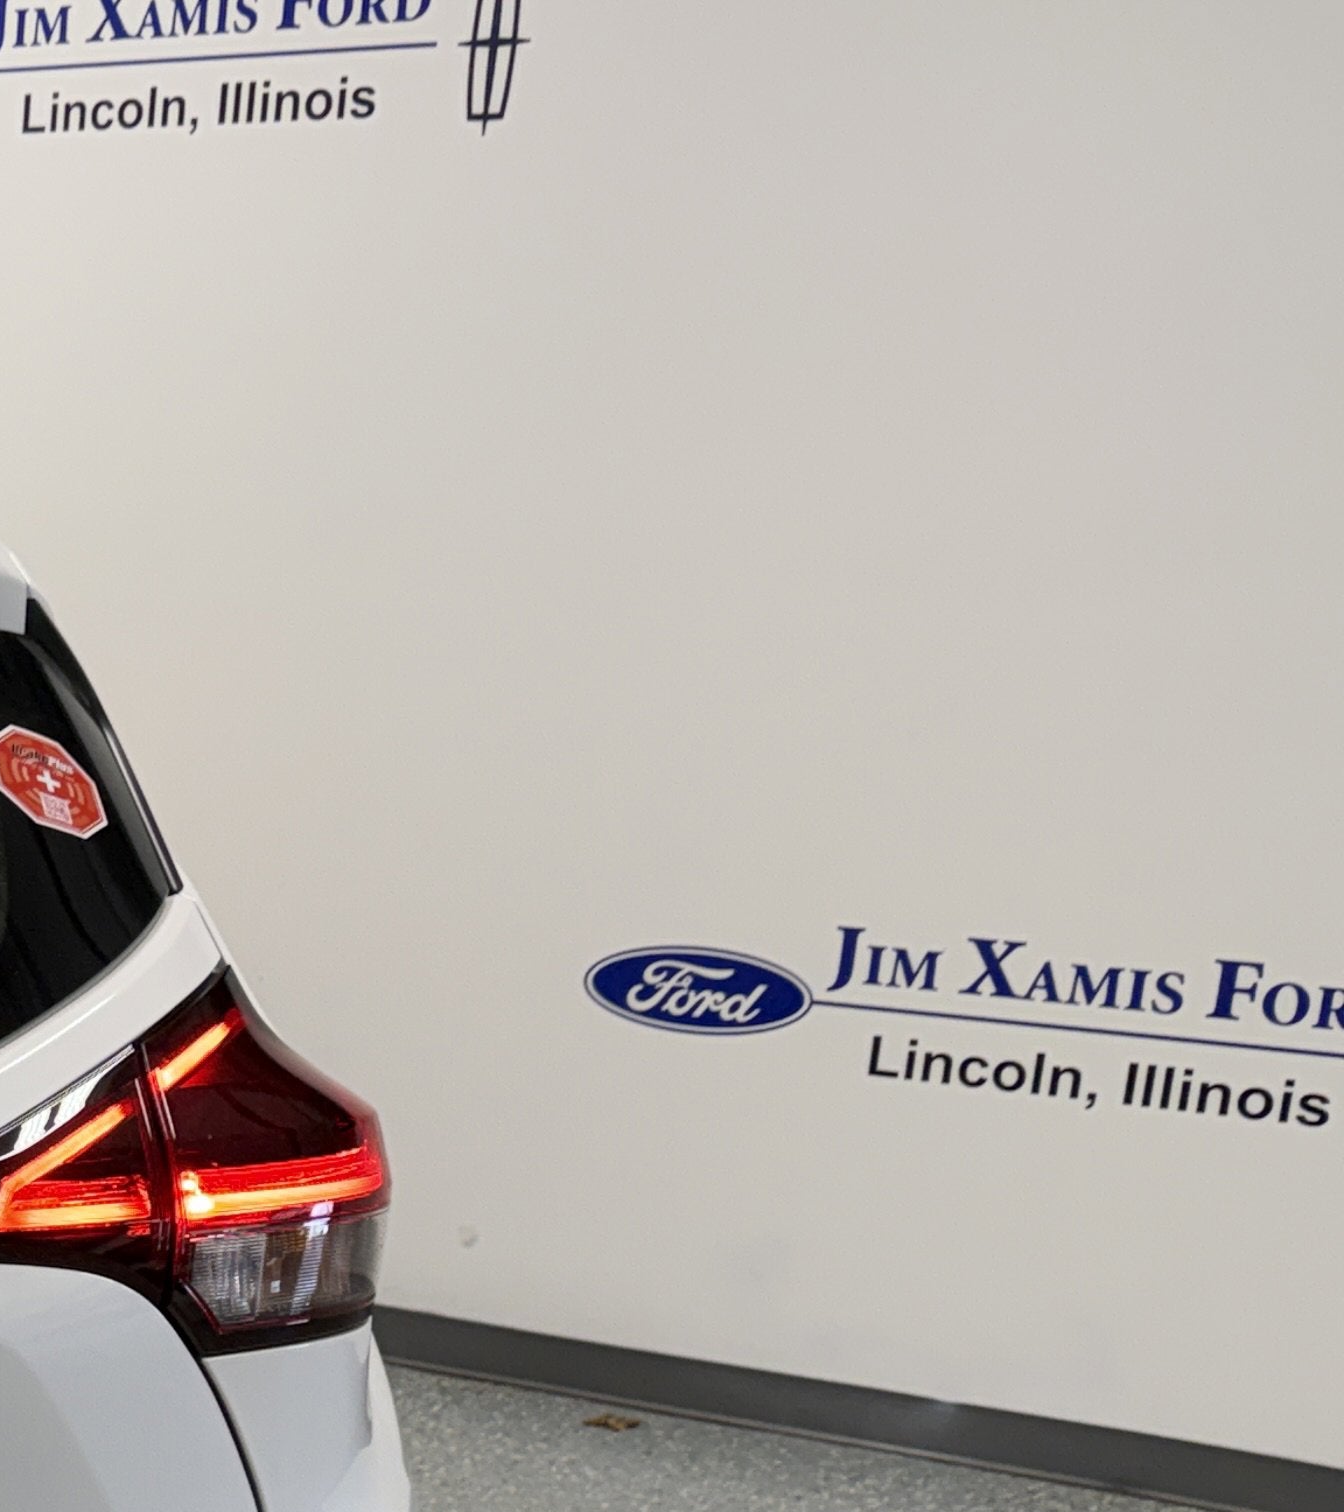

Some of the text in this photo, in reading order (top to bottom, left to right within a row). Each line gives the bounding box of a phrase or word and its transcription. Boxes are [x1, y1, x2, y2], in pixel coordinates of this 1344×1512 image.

[85, 0, 258, 43] XAMIS
[22, 77, 376, 134] Lincoln, Illinois
[626, 959, 763, 1023] Ford
[826, 926, 944, 992] JIM
[958, 937, 1185, 1015] XAMIS
[867, 1036, 1331, 1127] Lincoln, Illinois
